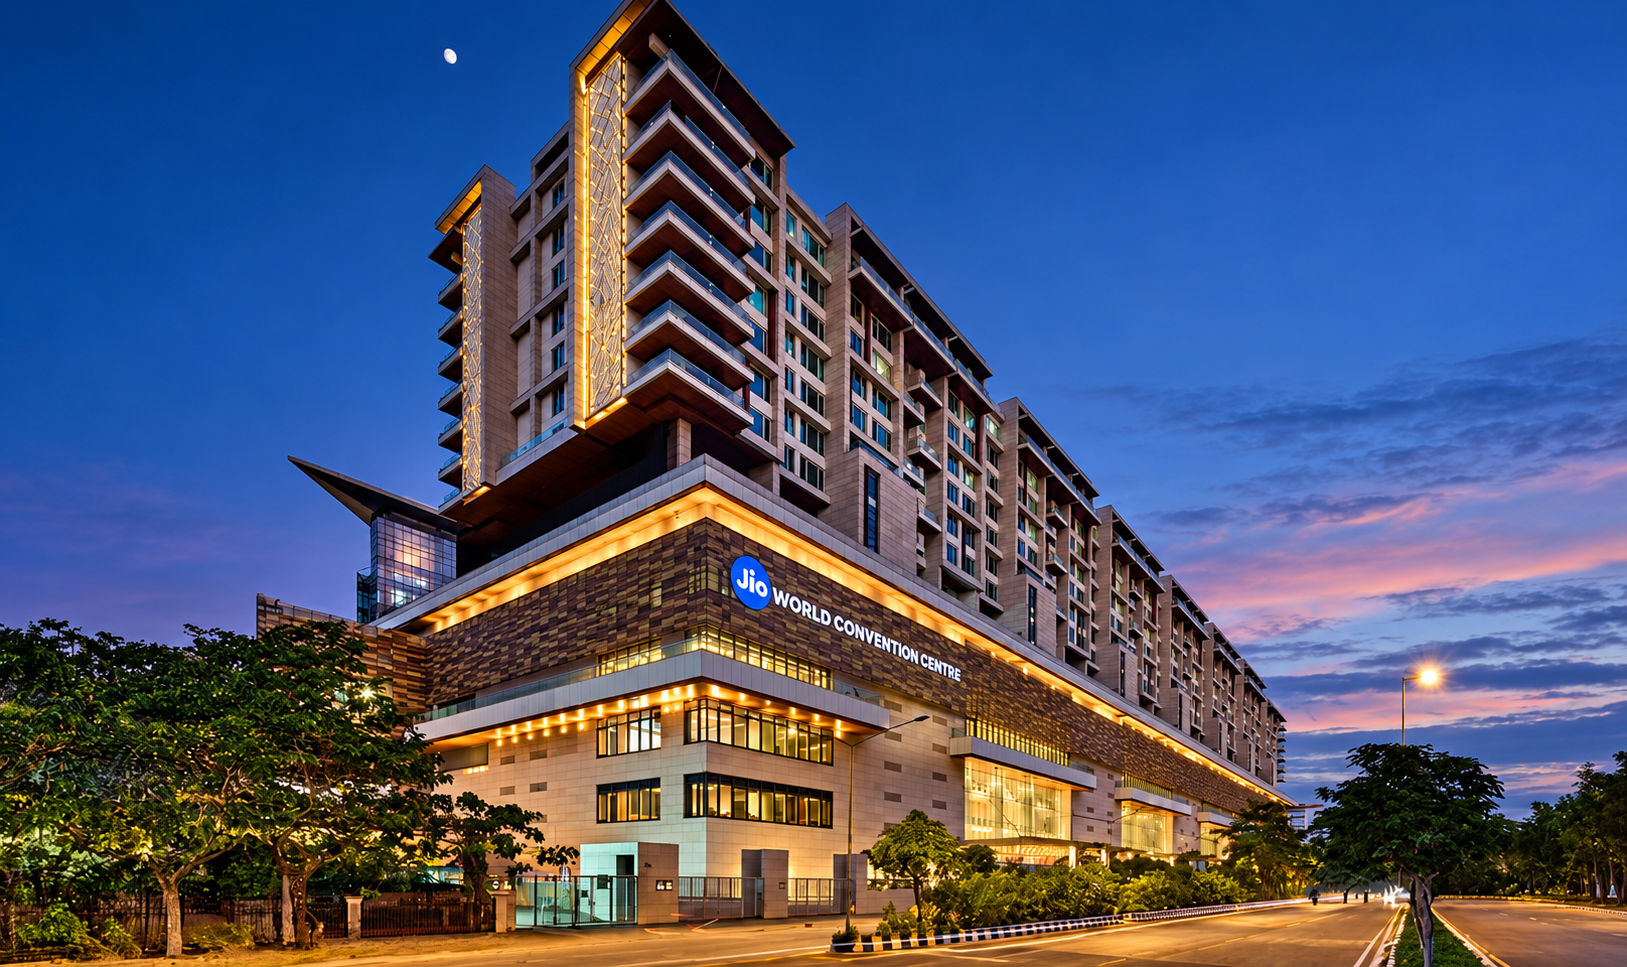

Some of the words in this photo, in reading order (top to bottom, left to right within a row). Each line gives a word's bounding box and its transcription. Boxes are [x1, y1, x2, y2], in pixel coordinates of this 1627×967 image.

[736, 568, 768, 598] Jio
[772, 586, 831, 626] WORLD
[833, 615, 920, 665] CONVENTION
[920, 653, 962, 682] CENTRE
